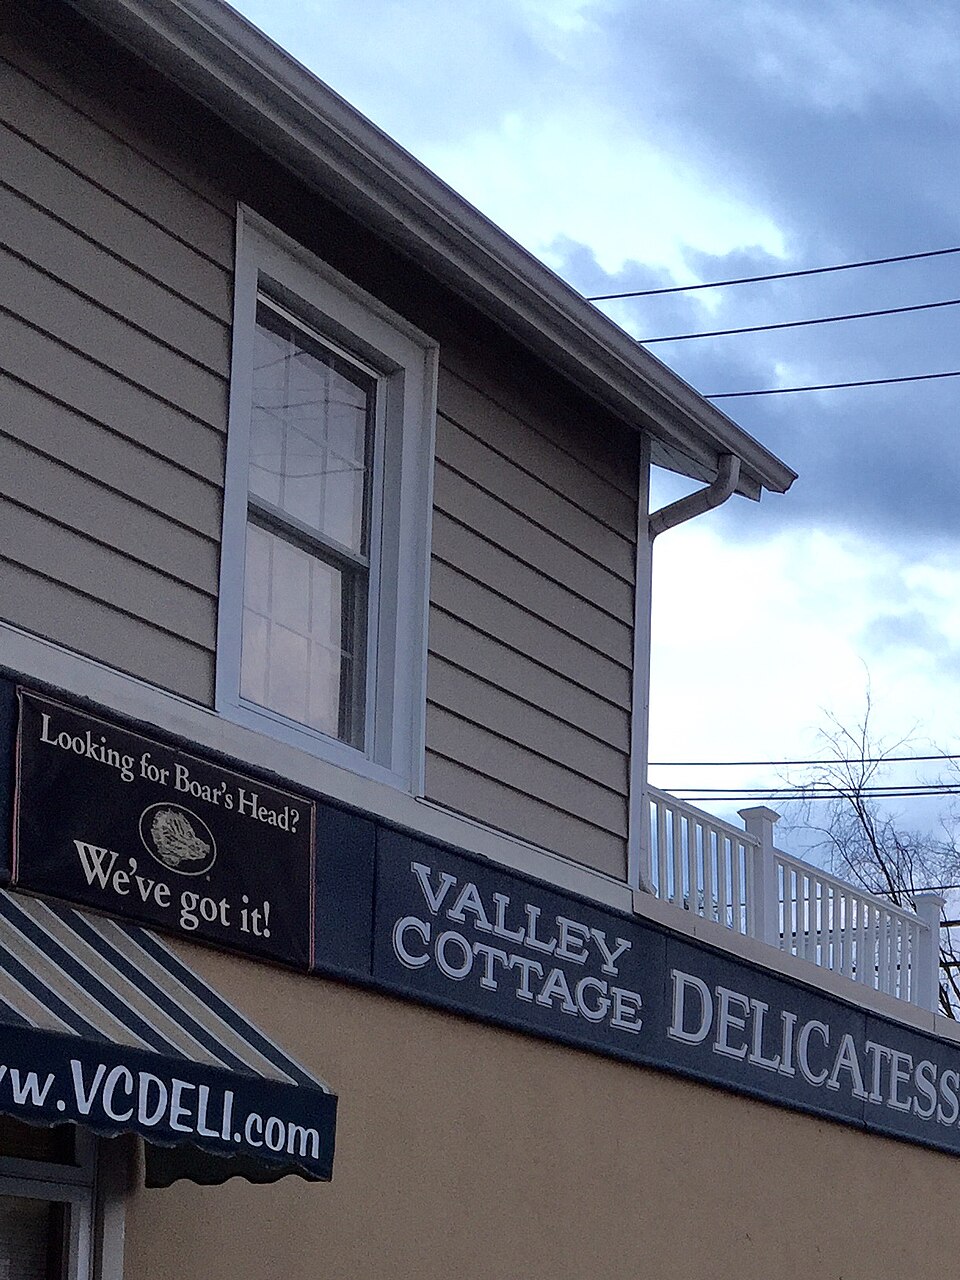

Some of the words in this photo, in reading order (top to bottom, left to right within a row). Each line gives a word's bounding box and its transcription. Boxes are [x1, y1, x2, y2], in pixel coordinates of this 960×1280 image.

[39, 713, 135, 782] Looking
[140, 753, 169, 785] for
[174, 763, 233, 810] Boar's
[238, 788, 300, 833] Head?
[73, 839, 171, 907] We've
[180, 891, 231, 930] got
[240, 895, 271, 938] it!
[410, 861, 632, 977] VALLEY
[392, 916, 643, 1034] COTTAGE
[0, 1059, 320, 1159] w.VCDELI.com
